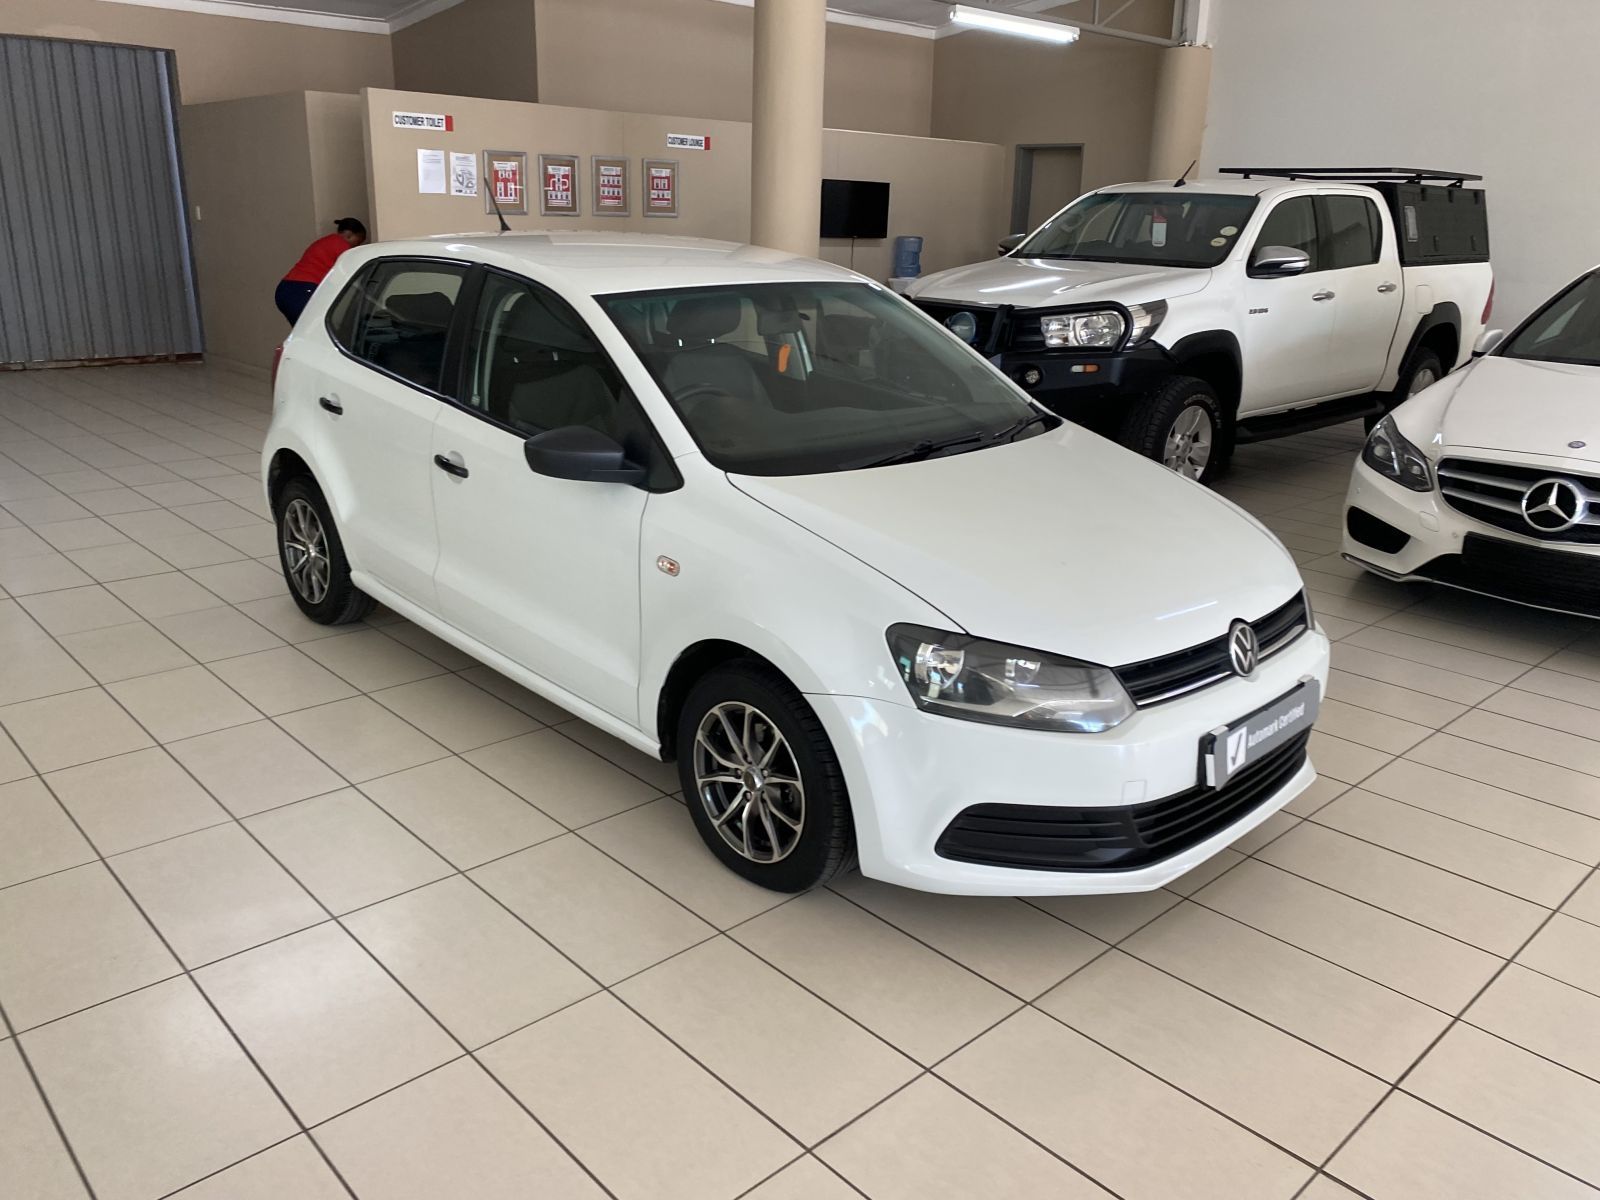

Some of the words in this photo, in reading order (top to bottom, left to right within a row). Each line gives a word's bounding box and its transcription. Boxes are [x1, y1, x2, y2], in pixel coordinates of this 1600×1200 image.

[394, 114, 425, 127] CUSTOMER
[425, 116, 444, 128] TOILET
[668, 135, 688, 146] CUSTOMER
[689, 138, 704, 148] LOUNGE
[1247, 719, 1279, 750] Automark
[1279, 702, 1305, 729] Certified
